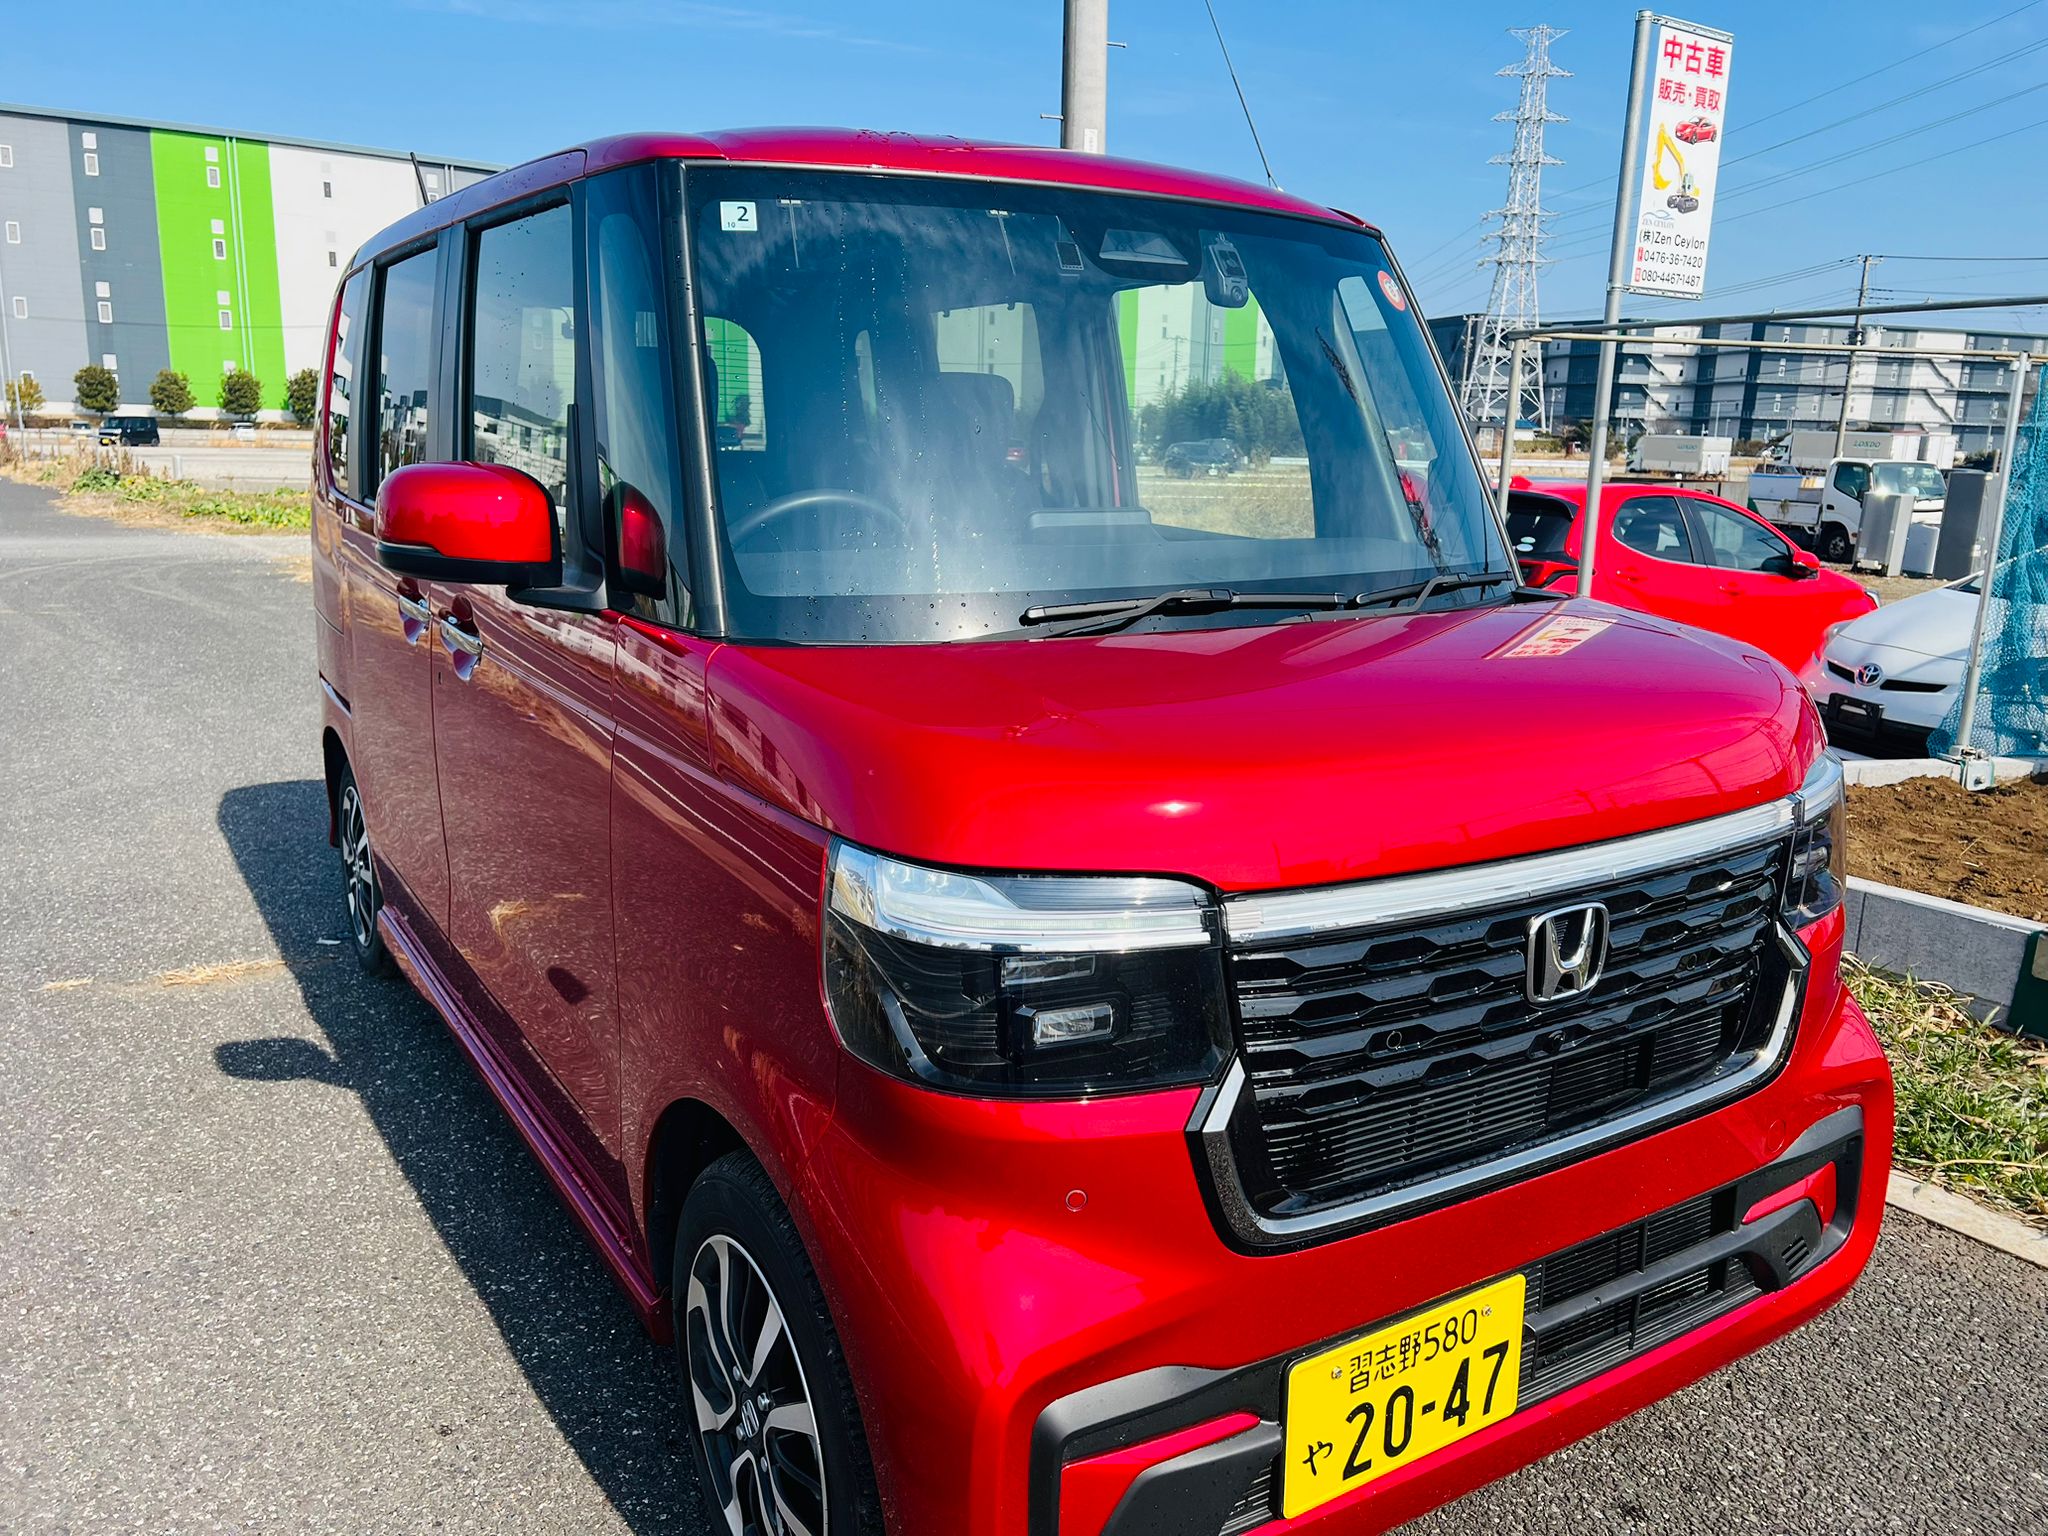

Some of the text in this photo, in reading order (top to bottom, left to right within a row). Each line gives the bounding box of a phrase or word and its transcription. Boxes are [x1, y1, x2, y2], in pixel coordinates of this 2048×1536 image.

[1663, 34, 1726, 78] 中古車
[1658, 78, 1721, 112] 販売・買取
[737, 205, 749, 222] 2
[1674, 234, 1706, 250] Ceylon
[1644, 250, 1704, 269] 0476-36-7420
[1641, 269, 1701, 287] 080-4467-1487
[1302, 1339, 1510, 1481] や 20-47
